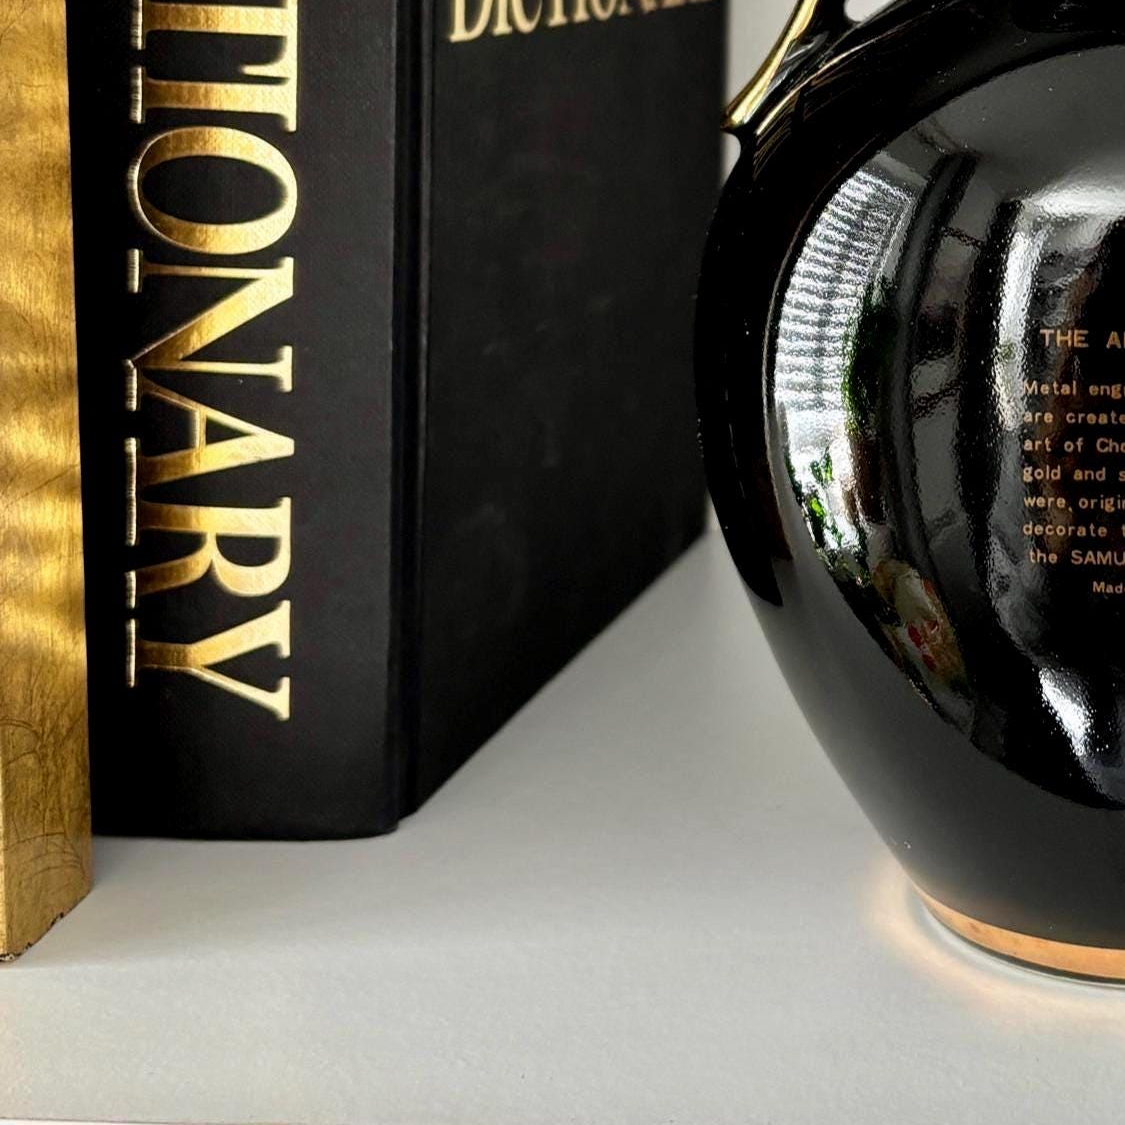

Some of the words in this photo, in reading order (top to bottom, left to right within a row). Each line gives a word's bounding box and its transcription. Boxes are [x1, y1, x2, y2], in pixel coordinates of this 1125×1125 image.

[1039, 329, 1089, 347] THE
[1023, 381, 1077, 396] Metal
[1023, 411, 1053, 423] are
[1023, 438, 1052, 451] art
[1064, 439, 1083, 452] of
[1022, 466, 1061, 483] gold
[1074, 468, 1106, 481] and
[1022, 523, 1107, 537] decorate
[1029, 550, 1058, 564] the
